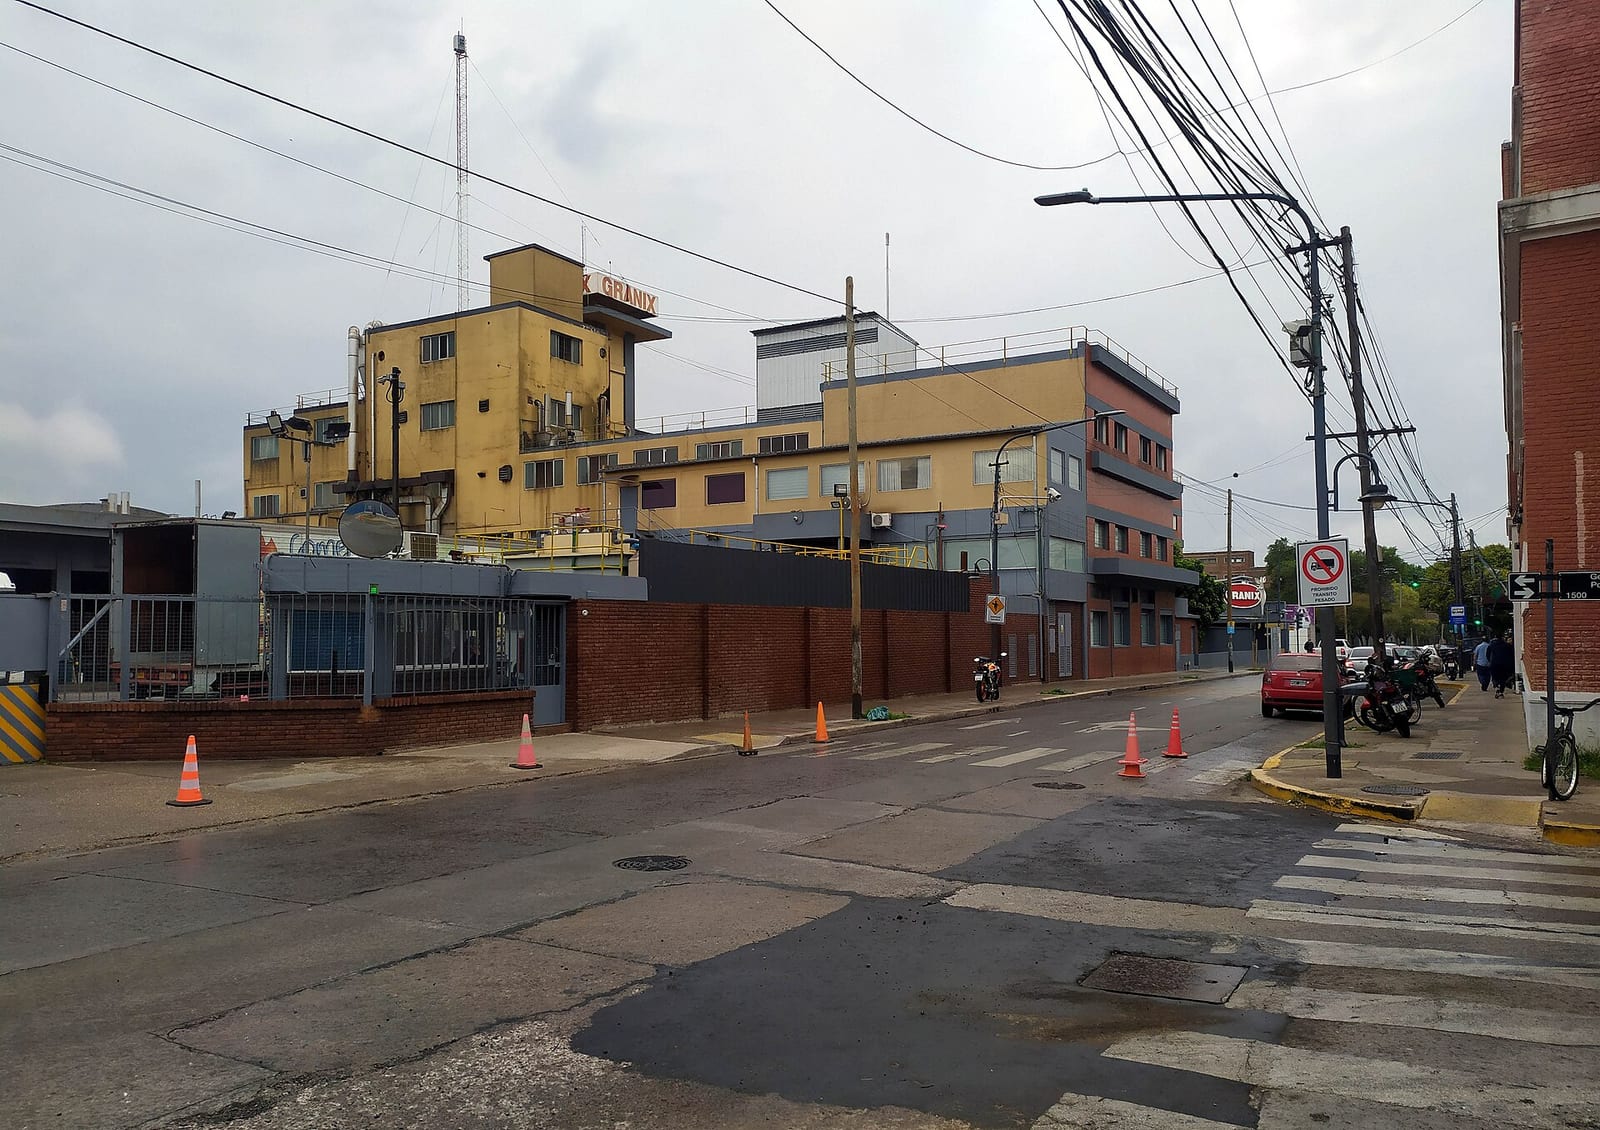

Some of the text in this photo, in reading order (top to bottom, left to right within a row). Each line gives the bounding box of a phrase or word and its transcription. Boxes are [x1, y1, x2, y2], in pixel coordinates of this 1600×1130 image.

[602, 276, 656, 314] GRANIX
[1225, 590, 1260, 600] RANIX
[1566, 591, 1587, 599] 1500
